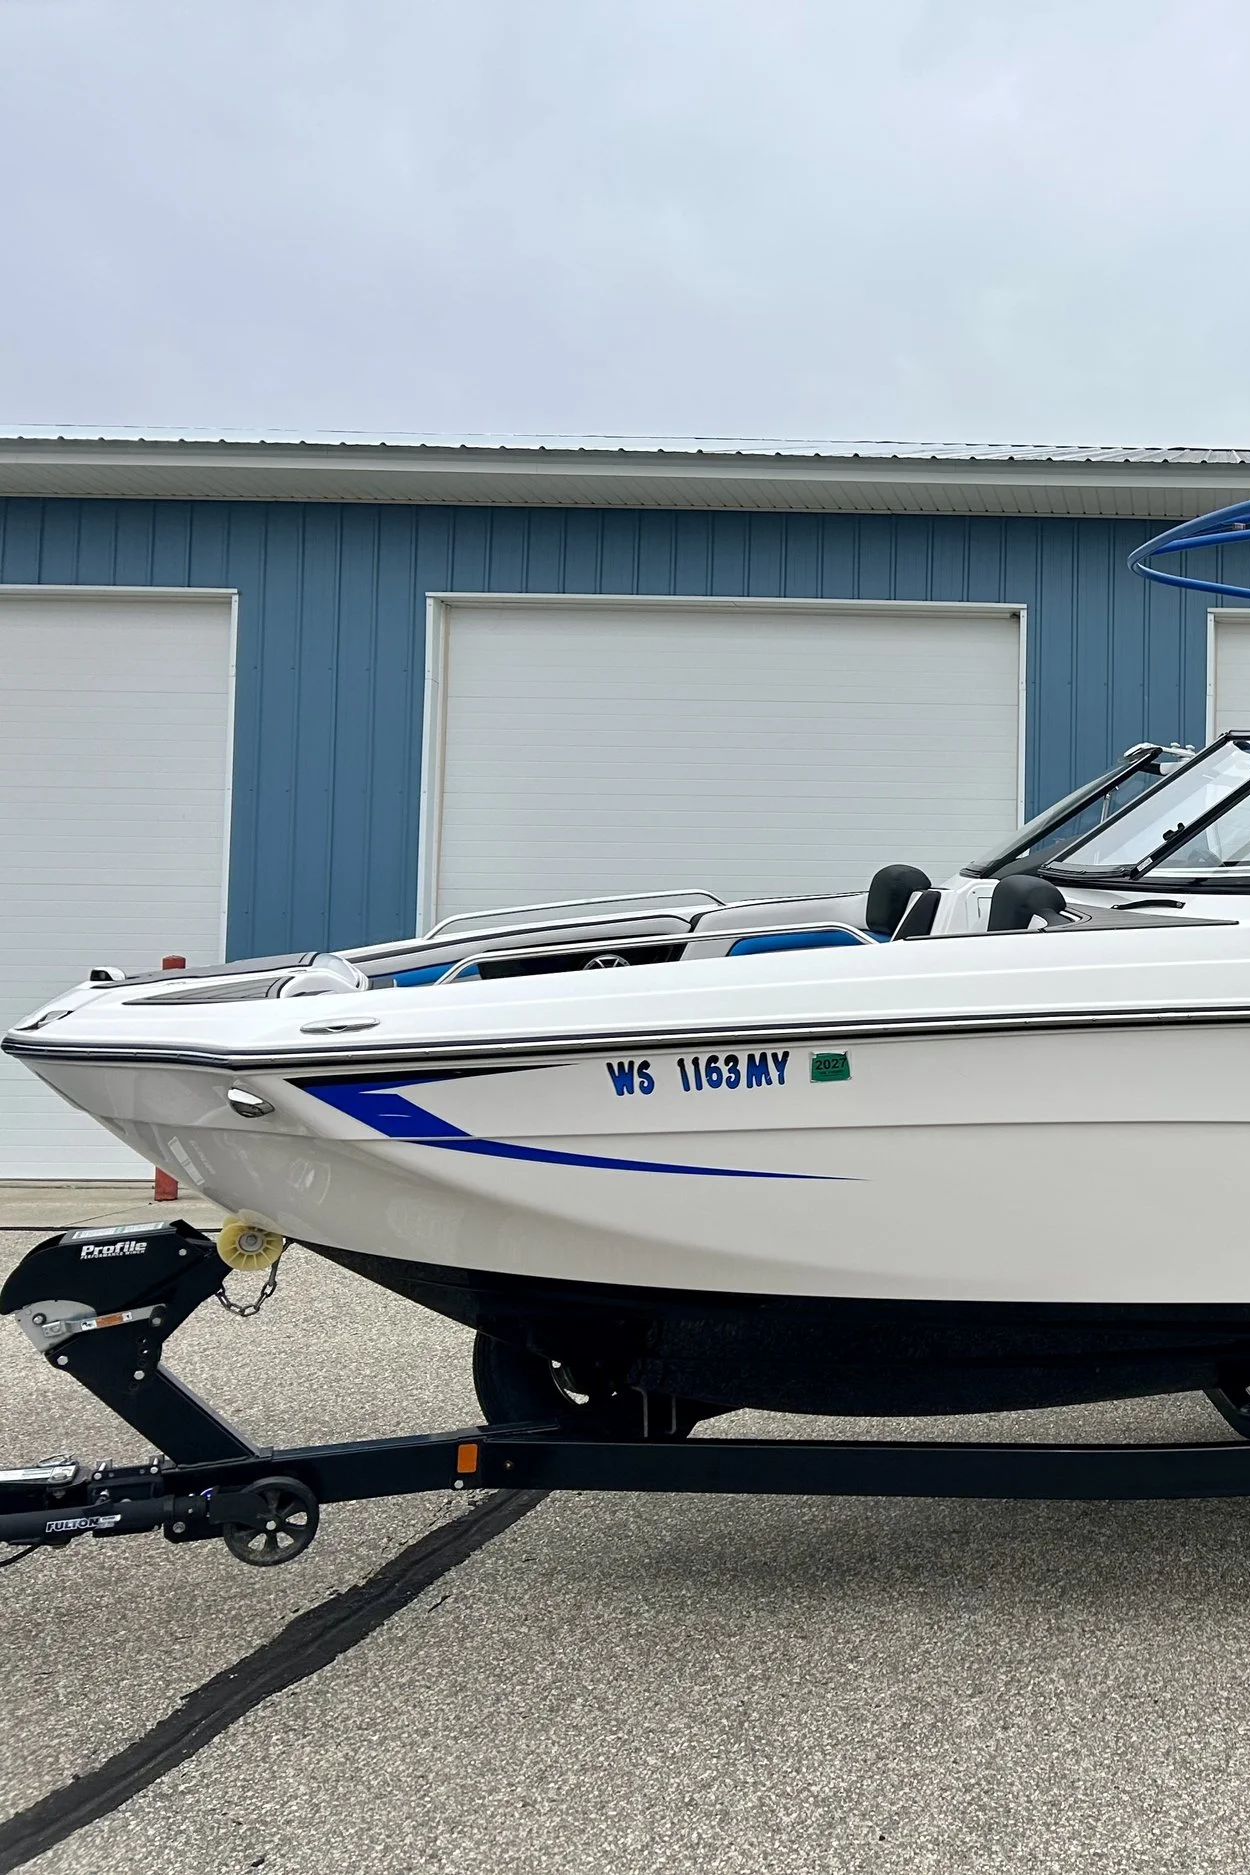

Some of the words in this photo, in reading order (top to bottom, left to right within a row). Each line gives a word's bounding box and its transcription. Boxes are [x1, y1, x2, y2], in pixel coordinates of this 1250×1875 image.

[815, 1058, 847, 1070] 2027
[606, 1060, 655, 1096] WS
[80, 1240, 147, 1257] Profile
[45, 1516, 100, 1533] FULTON
